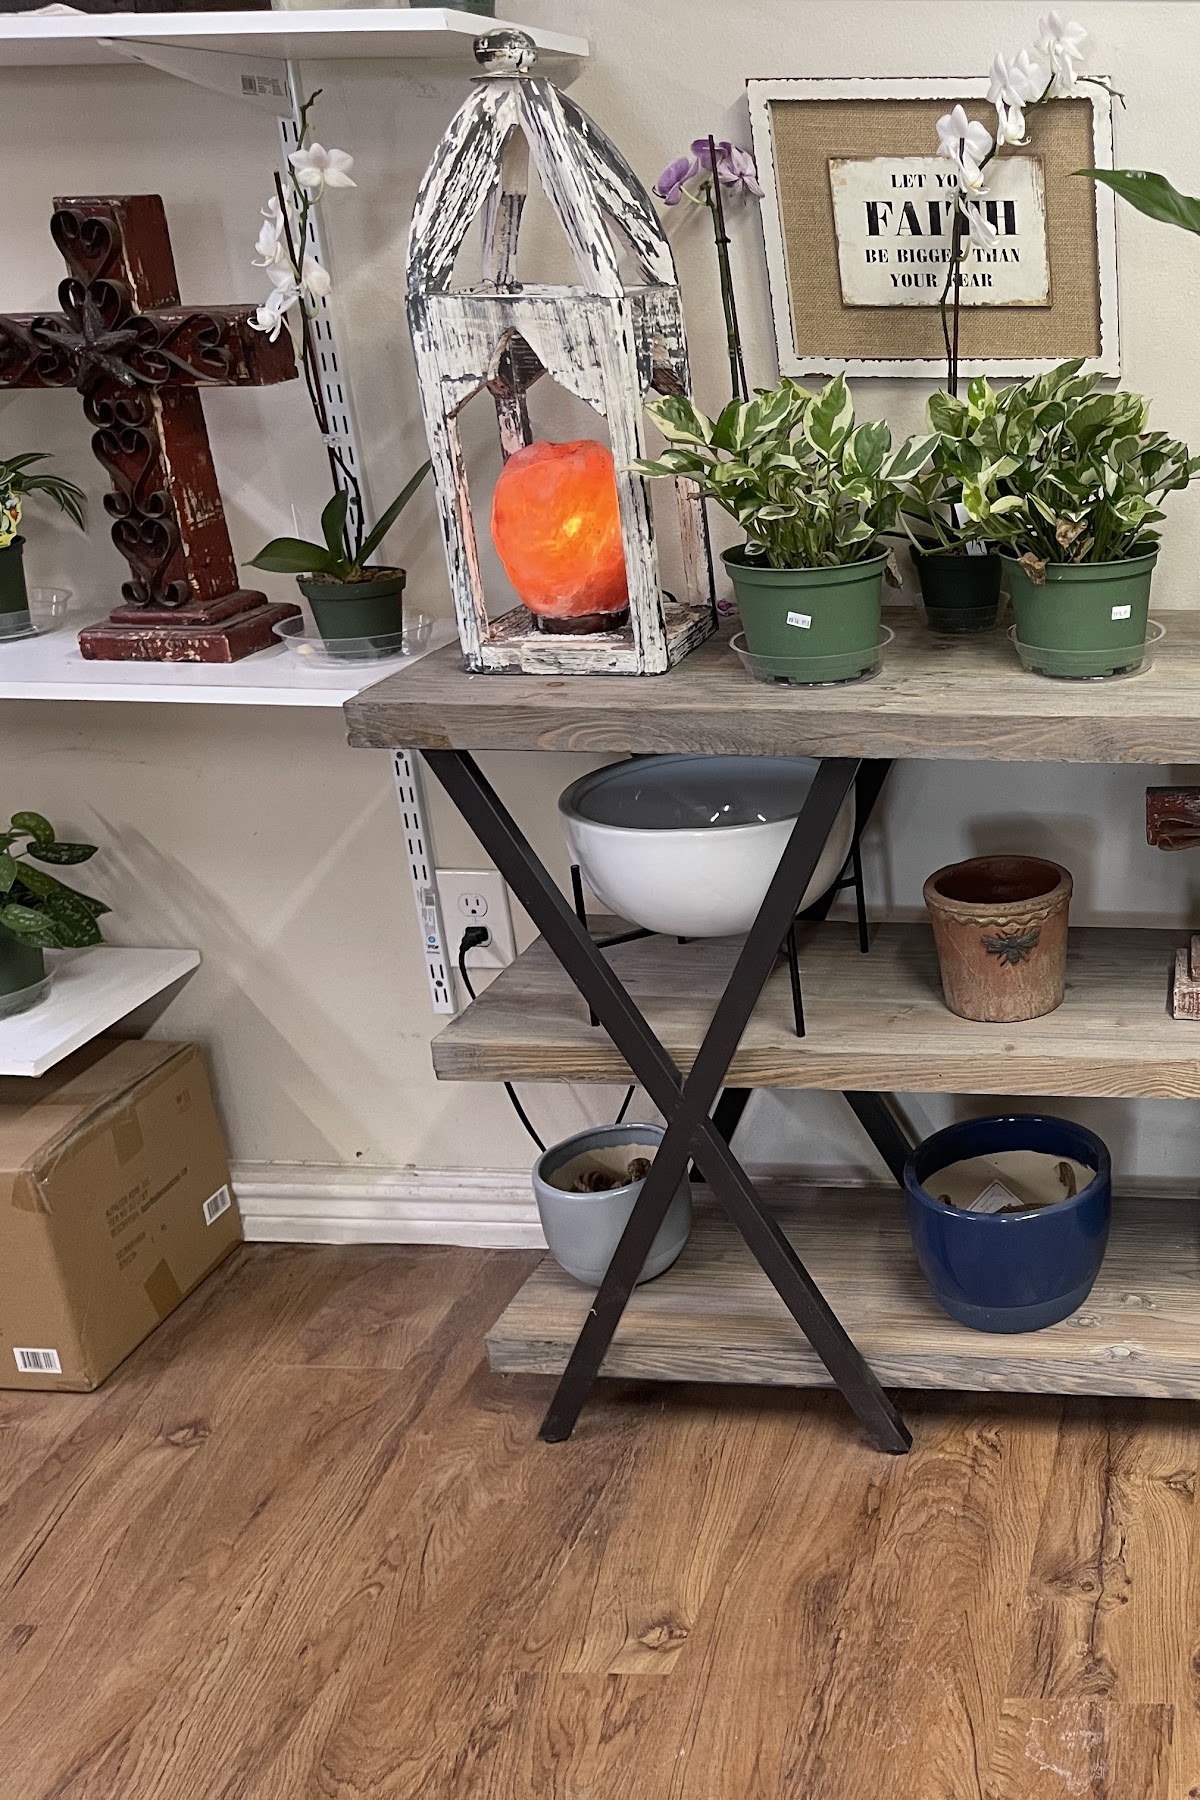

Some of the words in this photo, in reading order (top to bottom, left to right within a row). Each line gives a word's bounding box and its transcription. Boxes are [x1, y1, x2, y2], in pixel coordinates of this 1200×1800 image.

[891, 174, 926, 188] LET
[935, 174, 961, 188] YO
[866, 249, 889, 263] BE
[897, 249, 965, 263] BIGGE
[972, 249, 1020, 263] THAN
[890, 274, 939, 287] YOUR
